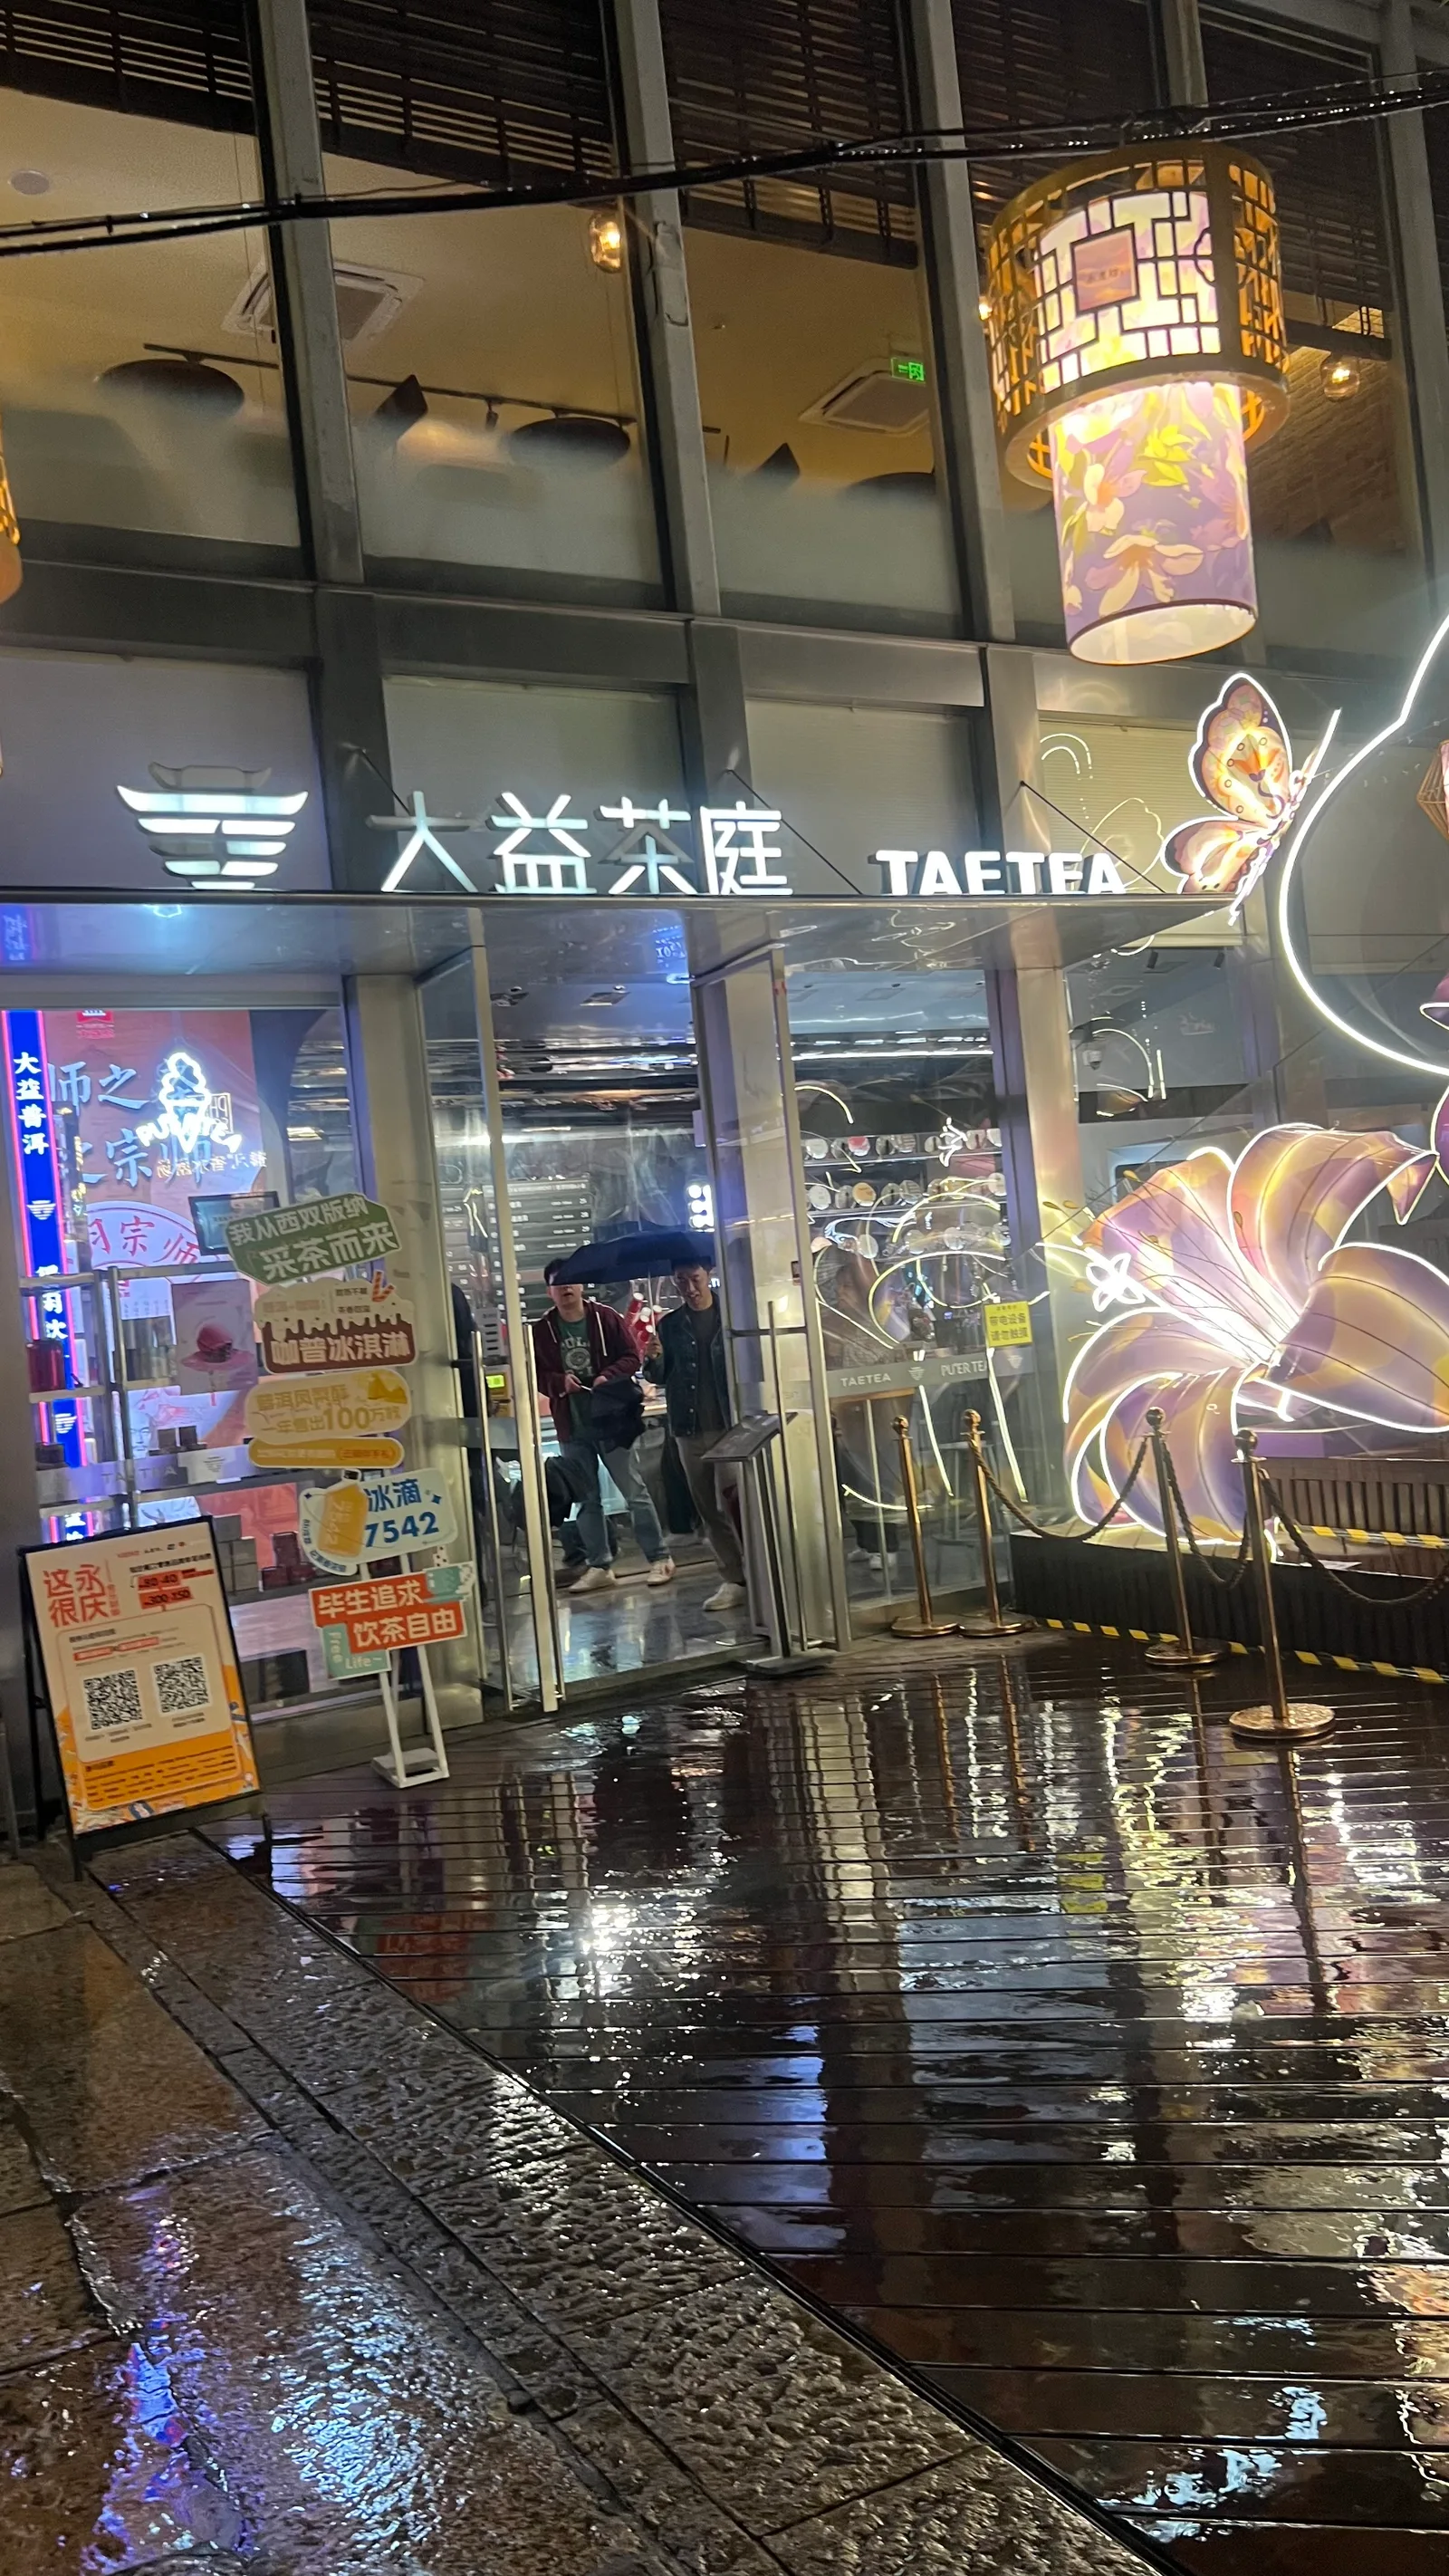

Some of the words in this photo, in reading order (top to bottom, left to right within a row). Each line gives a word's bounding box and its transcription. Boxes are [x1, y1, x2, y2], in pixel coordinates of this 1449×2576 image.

[365, 791, 793, 895] 大益茶庭
[876, 850, 1128, 895] TAETEA
[13, 1052, 49, 1155] 大益普洱
[228, 1195, 369, 1246] 我从西双版纳
[259, 1222, 398, 1281] 采茶而来
[840, 1373, 891, 1387] TAETEA
[363, 1478, 422, 1513] 冰滴
[365, 1511, 439, 1548] 7542
[318, 1579, 424, 1619] 毕生追求
[353, 1608, 457, 1648] 饮茶自由
